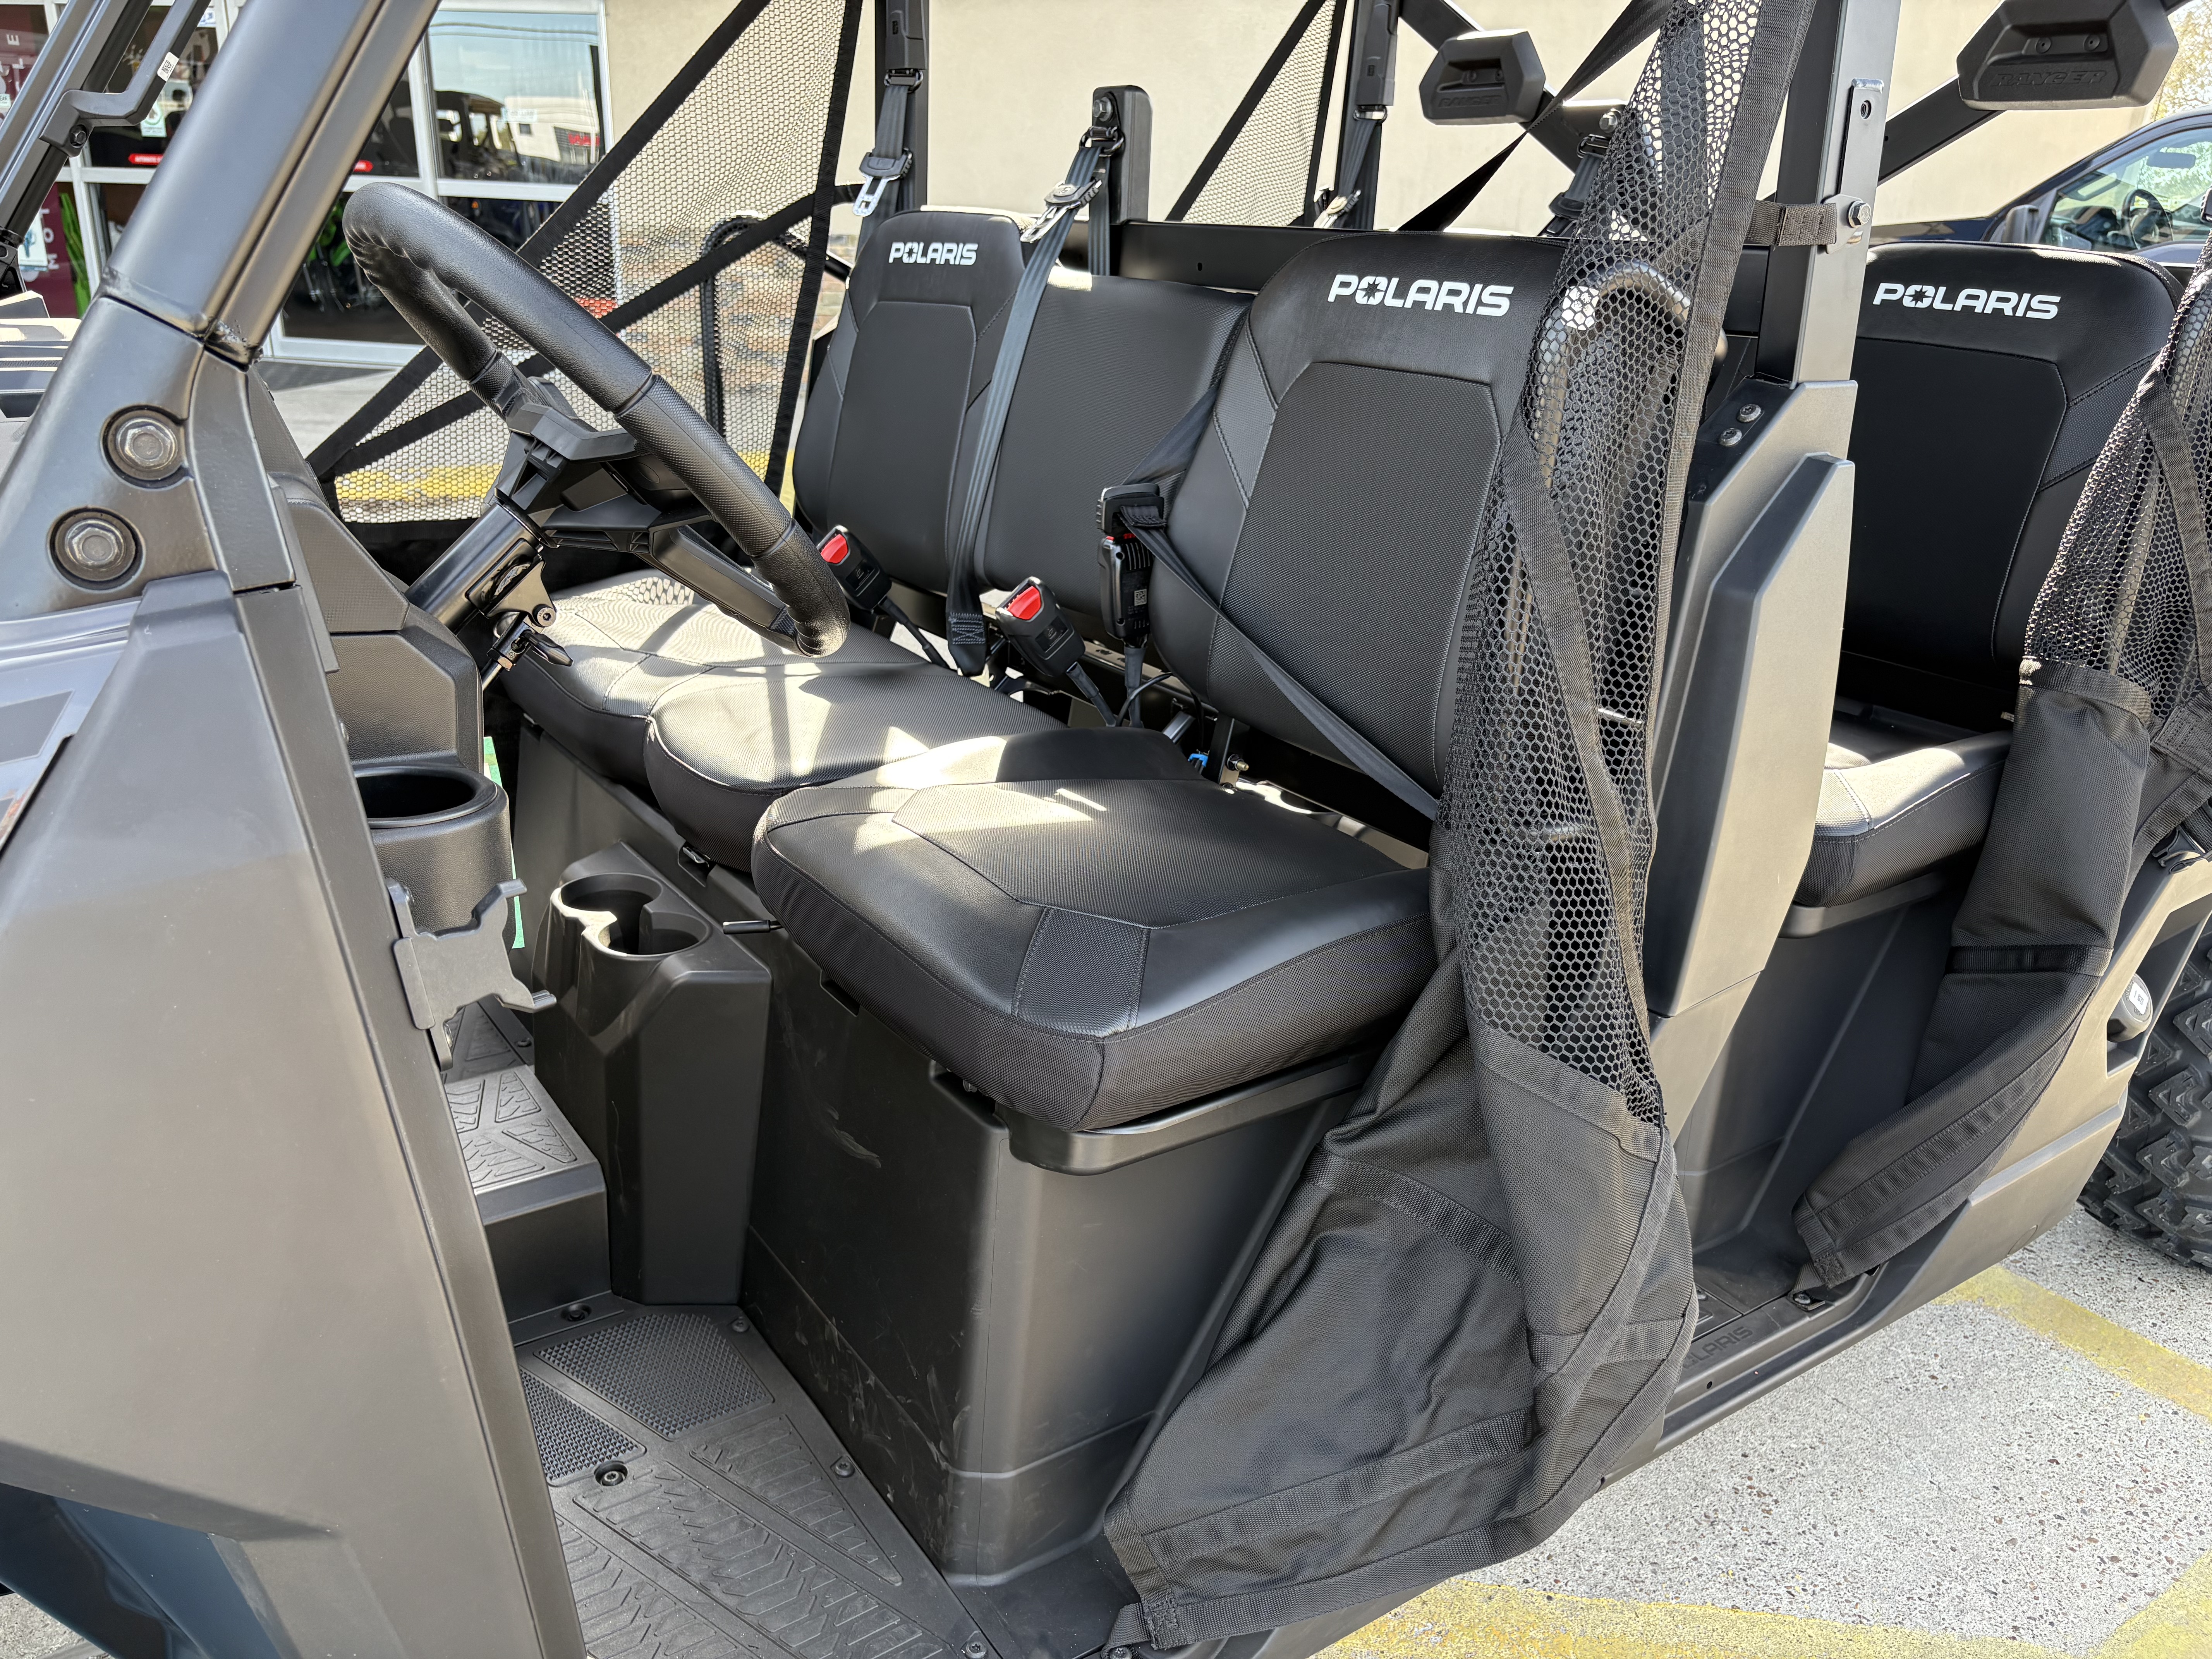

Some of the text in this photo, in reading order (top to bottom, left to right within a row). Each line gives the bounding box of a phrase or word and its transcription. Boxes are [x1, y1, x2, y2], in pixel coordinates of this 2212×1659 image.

[1990, 70, 2107, 87] RANGER
[888, 241, 978, 265] POLARIS
[1328, 274, 1514, 317] POLARIS
[1873, 282, 2061, 320] POLARIS
